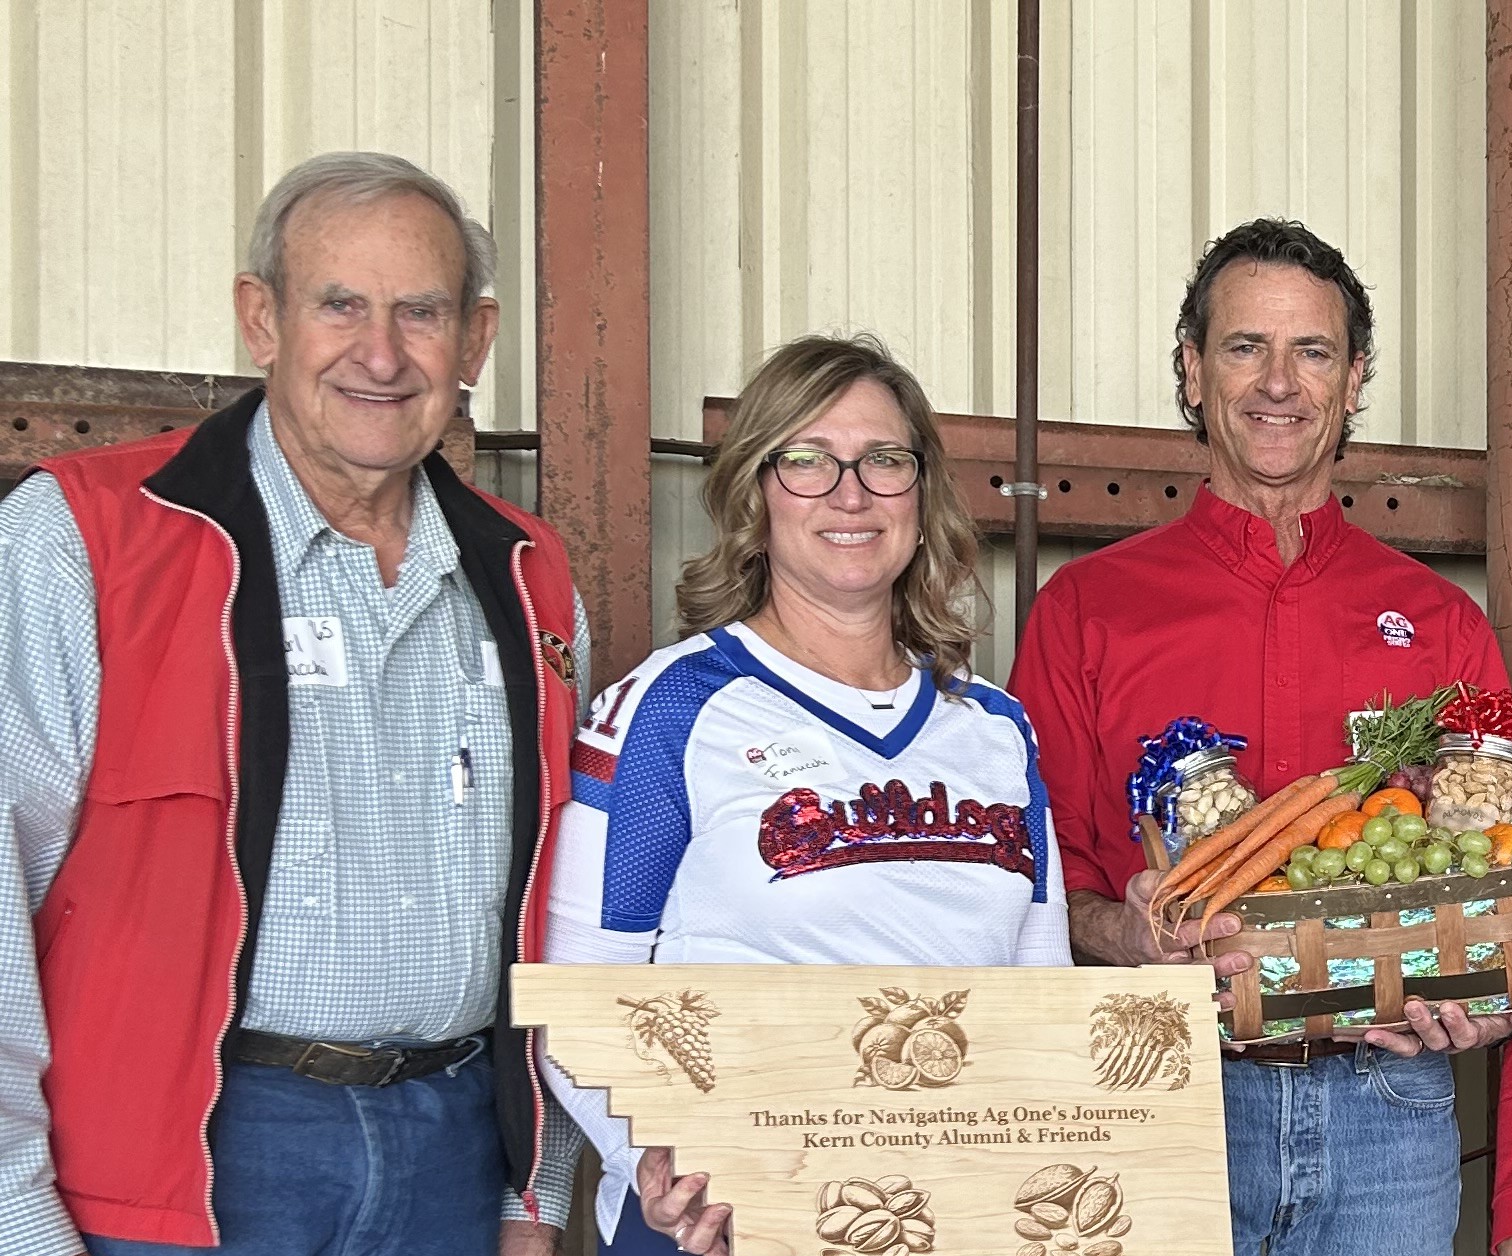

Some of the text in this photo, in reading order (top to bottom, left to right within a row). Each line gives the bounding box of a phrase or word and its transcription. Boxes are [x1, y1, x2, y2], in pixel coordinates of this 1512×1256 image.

[749, 1105, 1156, 1128] Thanks for Navigating Ag One's Journey.
[802, 1126, 1112, 1150] Kern County Alumni & Friends
